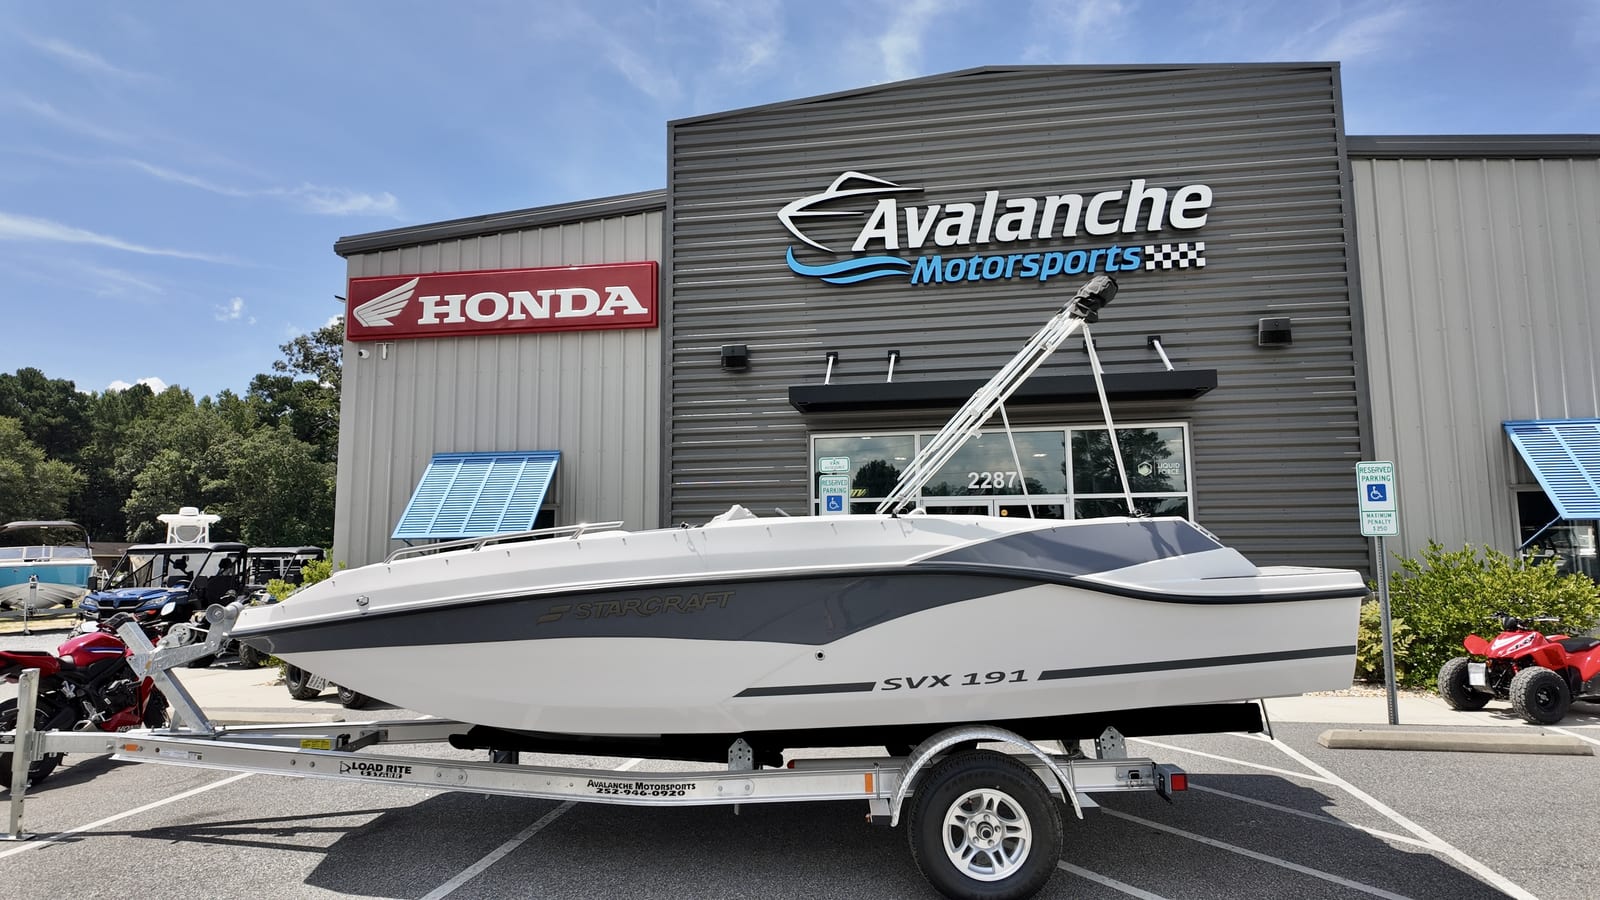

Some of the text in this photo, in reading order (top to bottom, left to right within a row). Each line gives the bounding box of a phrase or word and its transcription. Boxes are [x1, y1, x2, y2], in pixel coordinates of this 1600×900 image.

[851, 178, 1213, 252] Avalanche
[911, 244, 1141, 286] Motorsports
[417, 286, 649, 325] HONDA
[967, 471, 1018, 489] 2287
[1360, 466, 1392, 474] RESERVED
[575, 591, 736, 620] STARCRAFT
[880, 669, 1029, 691] SVX 191
[352, 762, 412, 774] LOAD RITE
[596, 787, 686, 797] 252-946-0920
